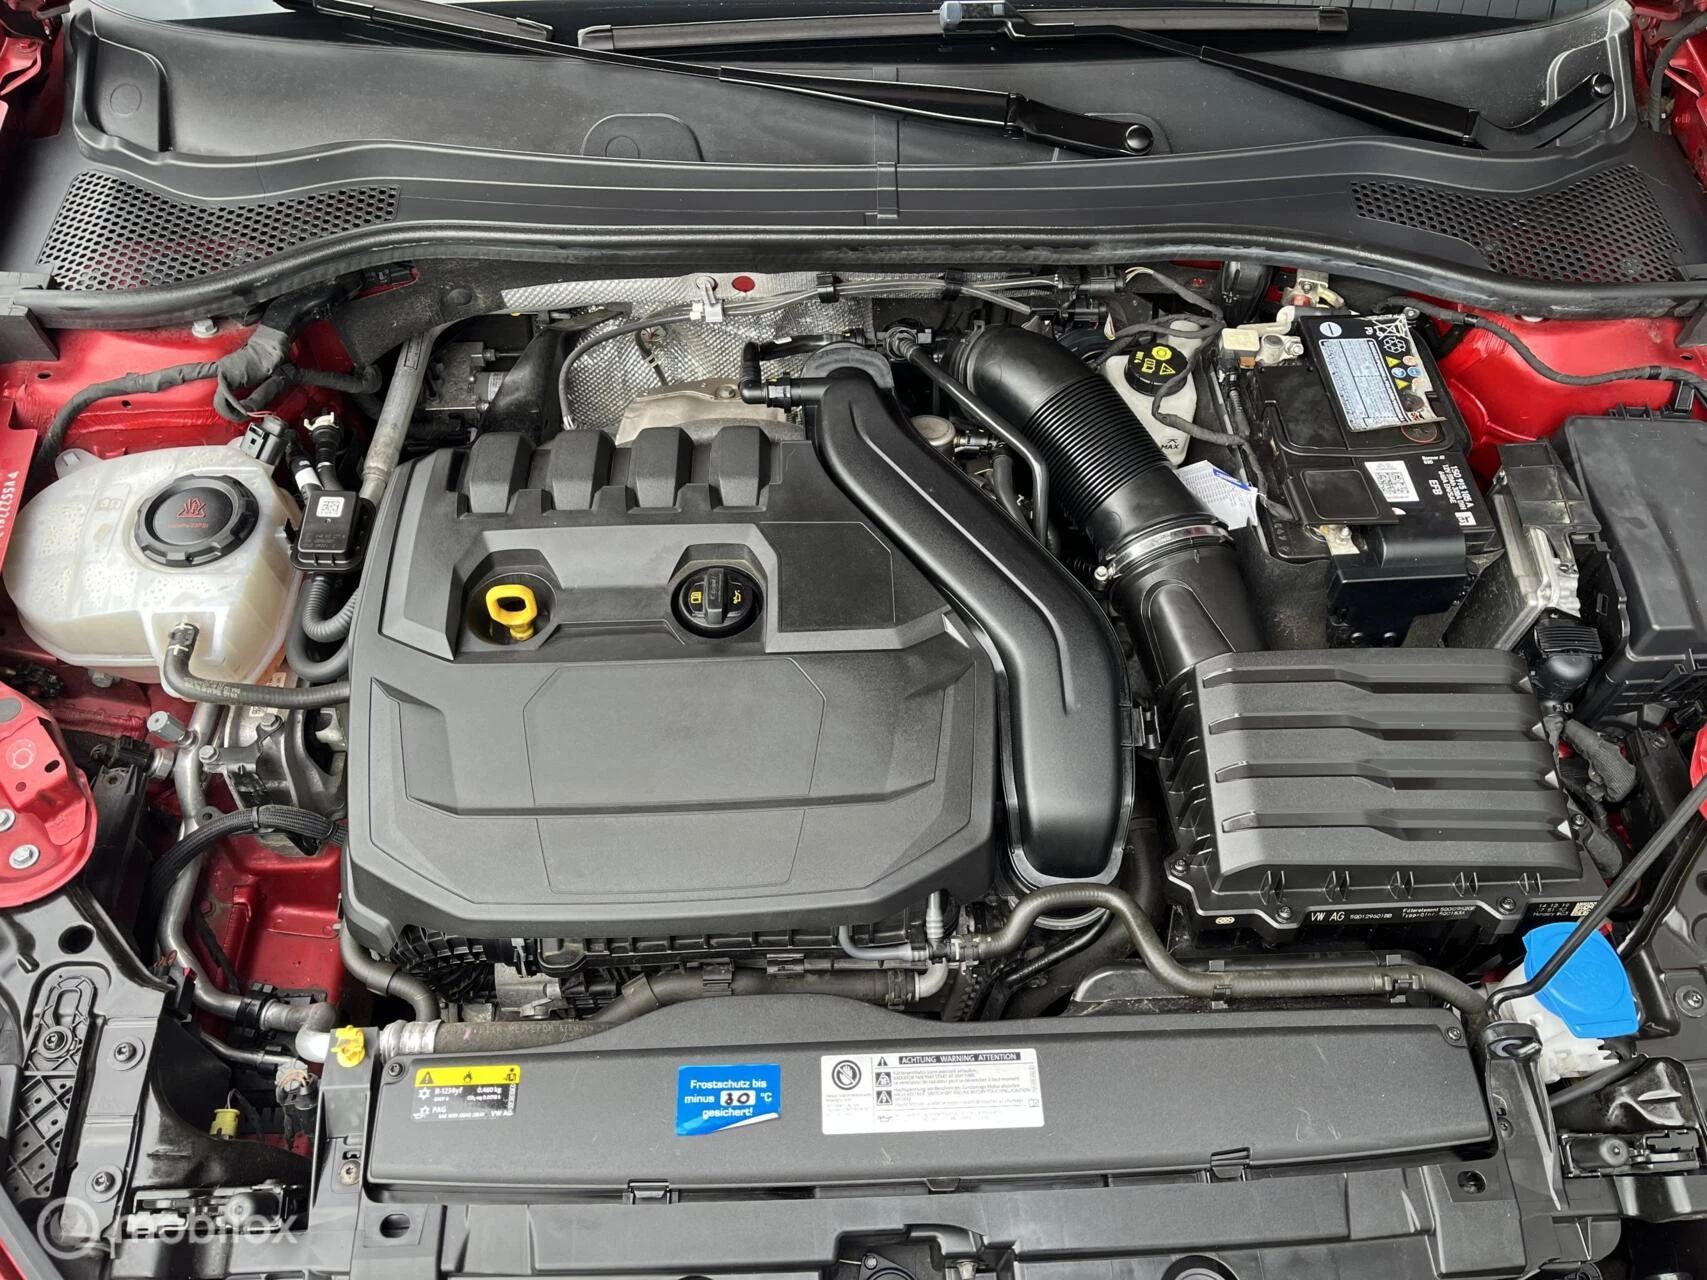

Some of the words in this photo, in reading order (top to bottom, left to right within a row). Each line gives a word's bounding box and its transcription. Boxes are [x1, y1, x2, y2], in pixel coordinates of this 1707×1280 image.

[1428, 480, 1443, 495] EFB
[1455, 478, 1468, 490] 915
[1461, 490, 1473, 502] 105
[1310, 912, 1327, 922] VW
[1329, 911, 1345, 922] AG
[901, 1055, 937, 1064] ACHTUNG
[939, 1054, 975, 1064] WARNING
[977, 1052, 1017, 1062] ATTENTION
[690, 1079, 750, 1089] Frostschutz
[752, 1078, 768, 1089] bis
[684, 1094, 715, 1104] minus
[432, 1105, 447, 1114] PAG
[702, 1107, 753, 1119] gesichert!
